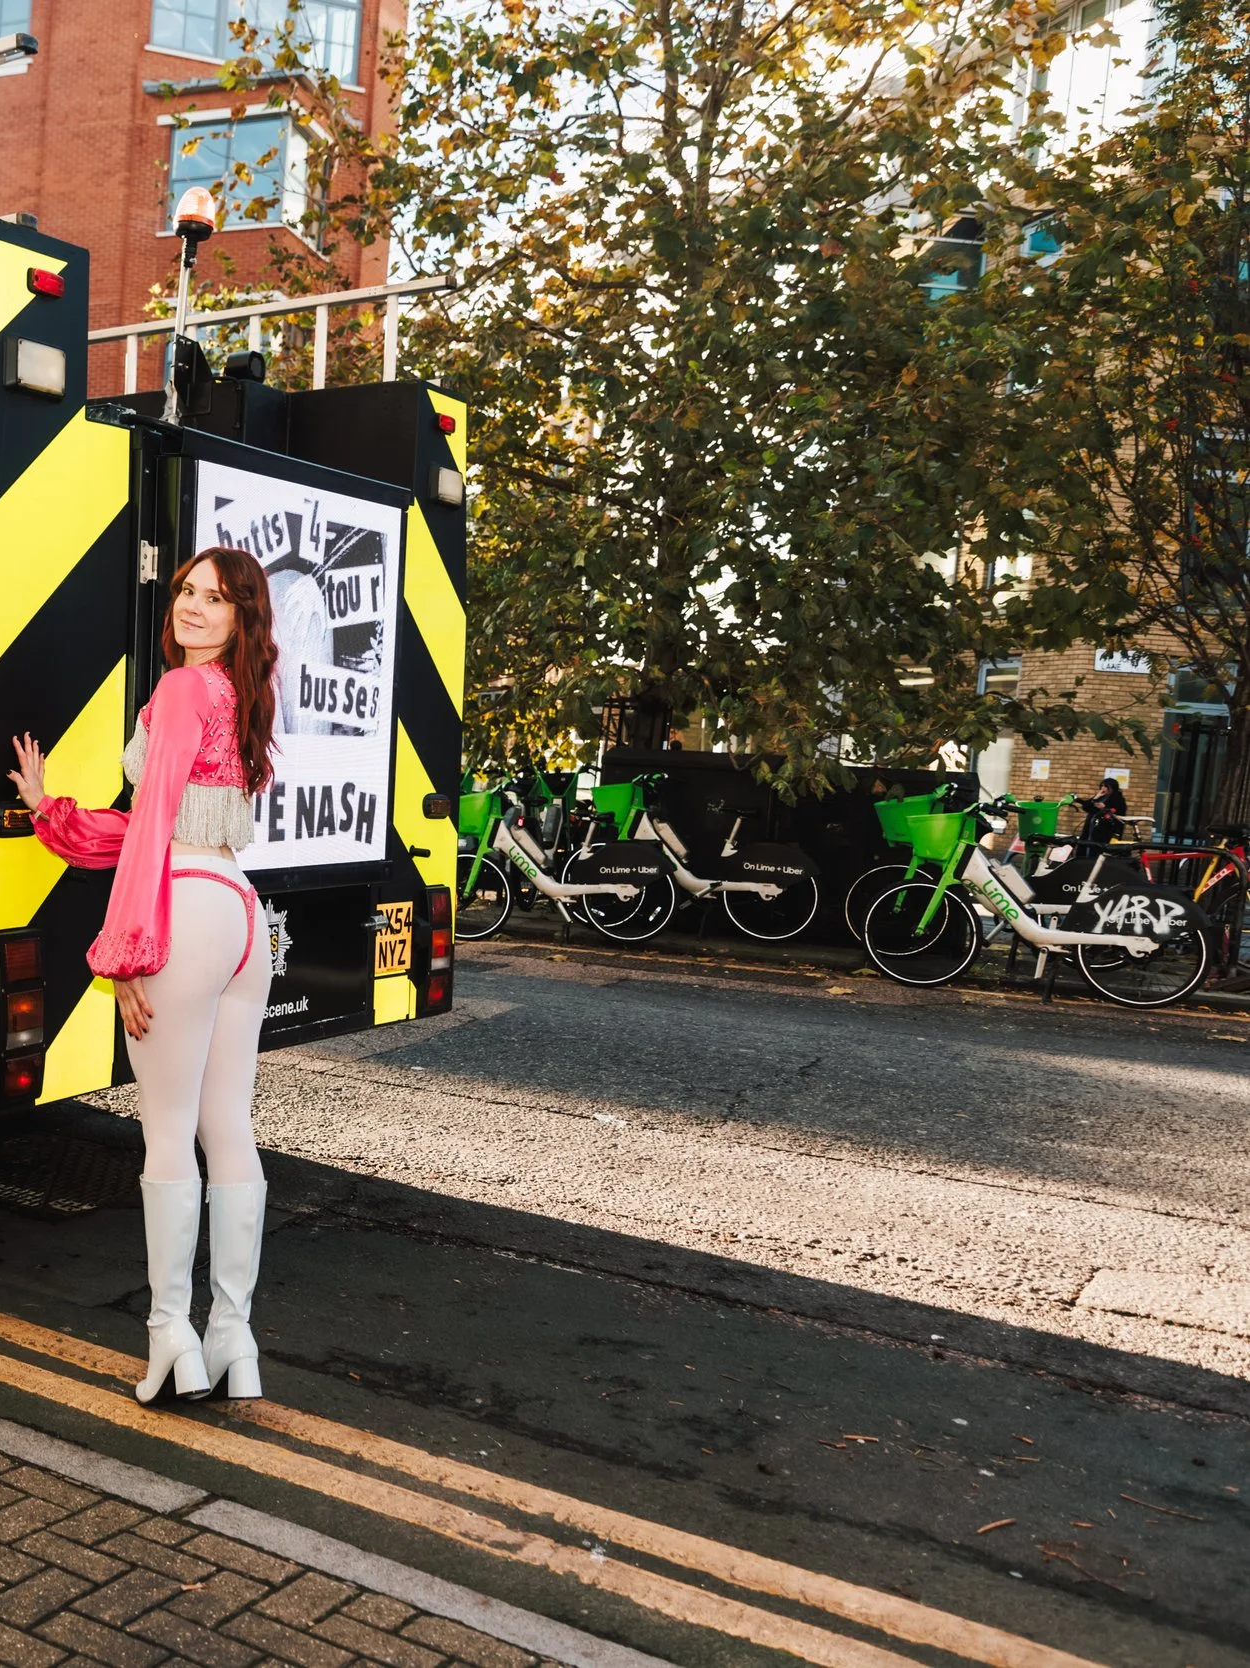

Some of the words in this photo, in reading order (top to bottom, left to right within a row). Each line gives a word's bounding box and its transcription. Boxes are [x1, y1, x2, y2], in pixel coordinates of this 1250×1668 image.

[295, 782, 377, 845] NASH
[508, 845, 538, 879] Lime
[612, 866, 631, 874] Lime
[638, 866, 658, 874] Uber
[743, 862, 755, 870] On
[756, 863, 776, 872] Lime
[782, 865, 803, 875] Uber
[982, 879, 1020, 921] Lime
[1062, 884, 1076, 892] On
[378, 939, 407, 968] NYZ
[263, 996, 310, 1019] scene.uk
